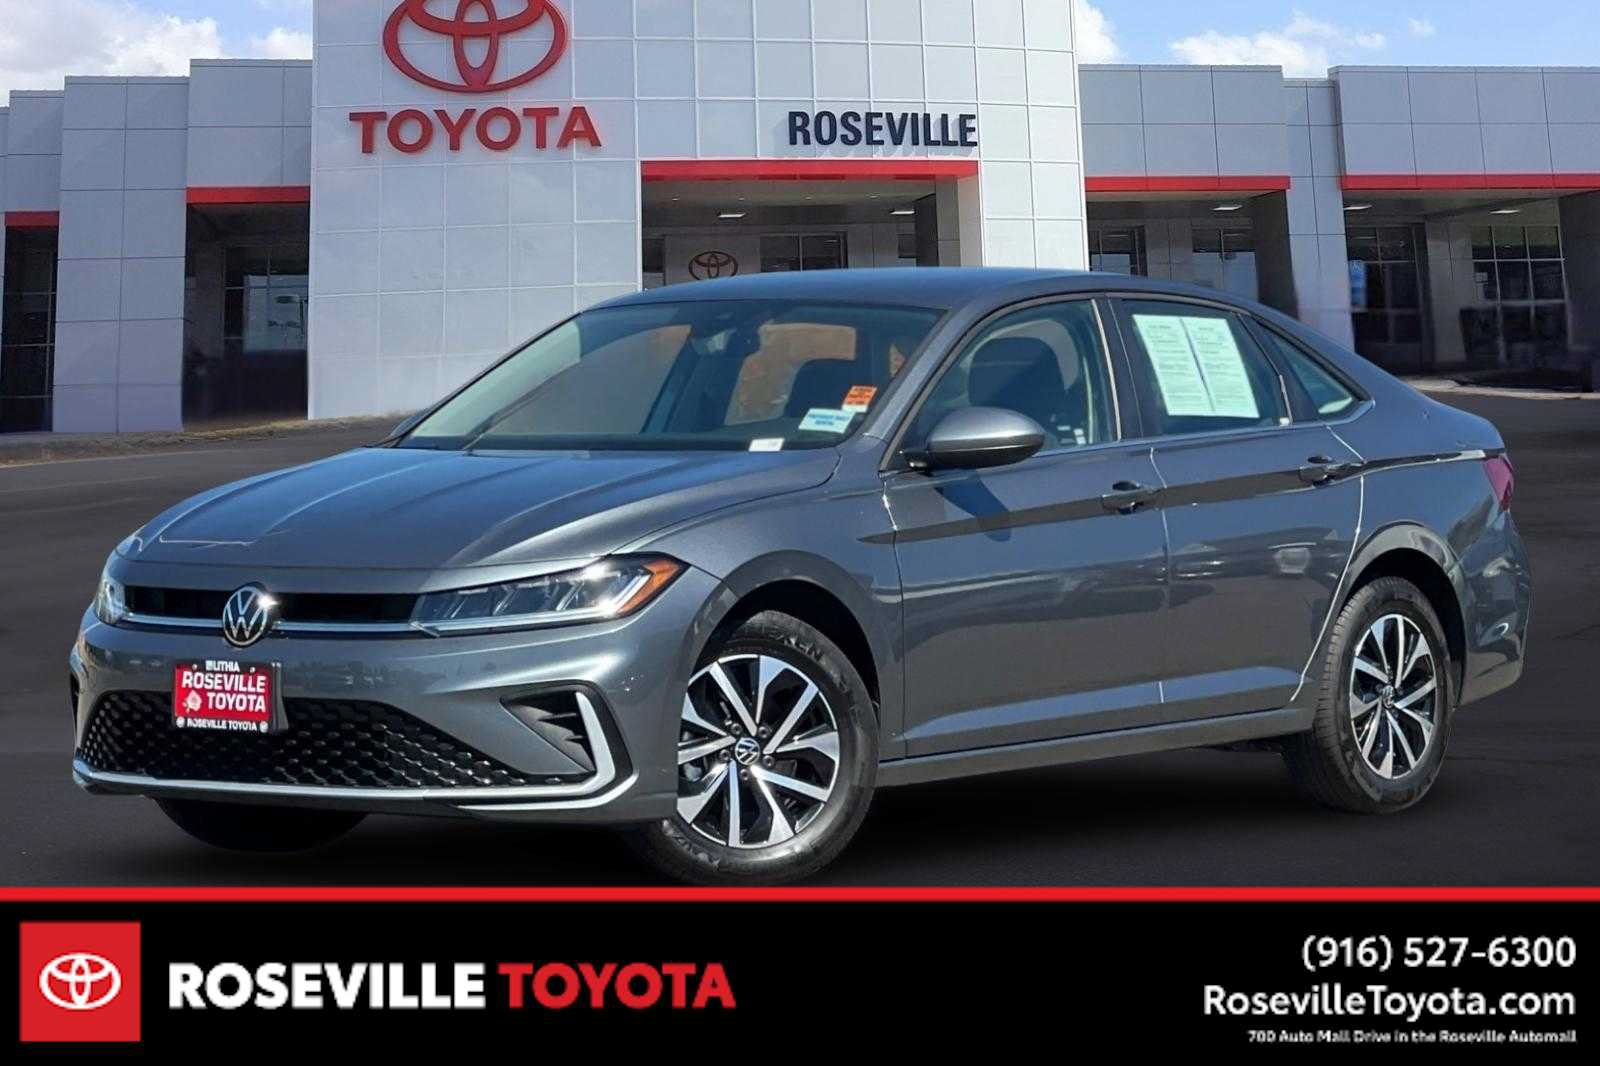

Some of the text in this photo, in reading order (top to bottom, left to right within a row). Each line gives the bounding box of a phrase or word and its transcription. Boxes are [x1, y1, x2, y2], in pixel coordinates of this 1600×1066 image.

[350, 106, 602, 153] TOYOTA
[788, 110, 978, 147] ROSEVILLE
[182, 671, 266, 692] ROSEVILLE
[207, 692, 266, 712] TOYOTA
[187, 717, 258, 731] ROSEVILLE TOYOTA
